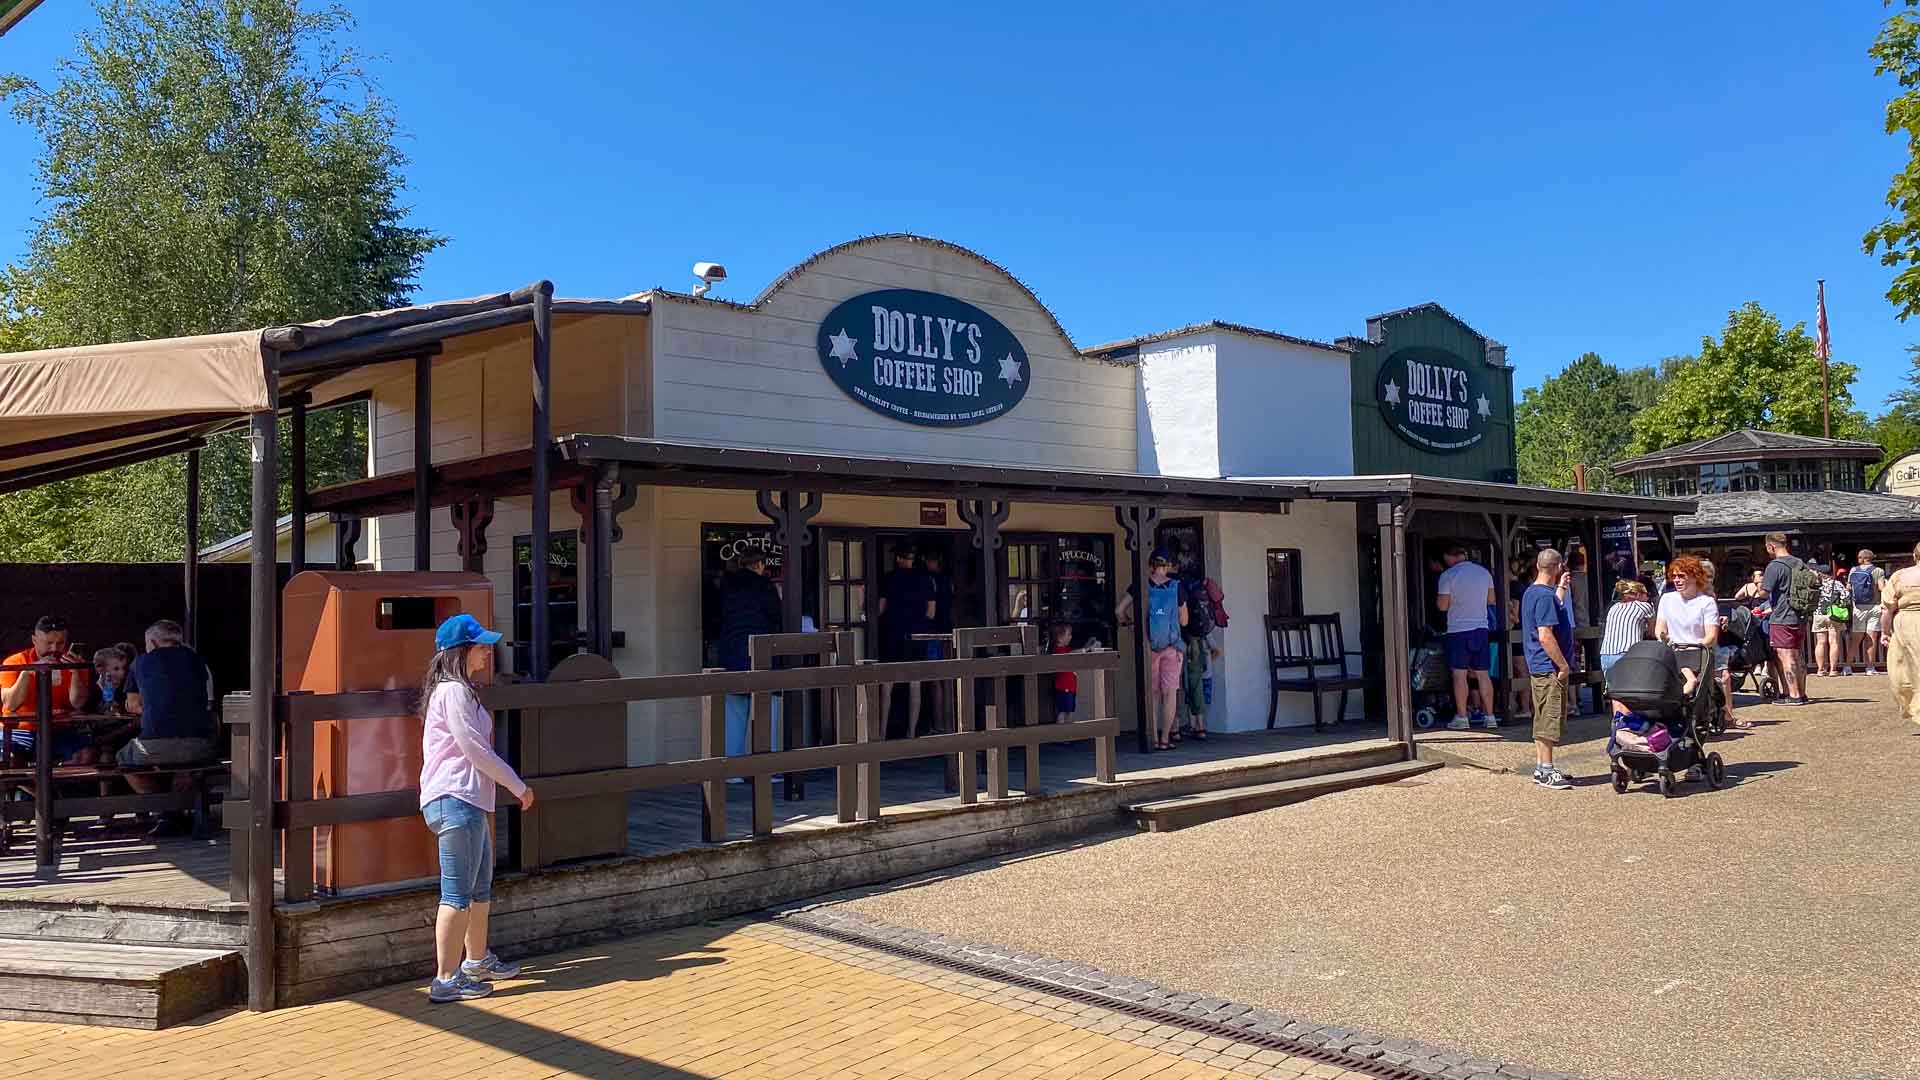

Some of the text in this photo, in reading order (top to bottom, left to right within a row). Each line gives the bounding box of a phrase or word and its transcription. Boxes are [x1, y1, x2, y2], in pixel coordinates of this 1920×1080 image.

[871, 305, 983, 365] DOLLY'S
[873, 356, 983, 397] COFFEE SHOP
[1406, 359, 1468, 403] DOLLY'S
[1408, 399, 1469, 430] COFFEE SHOP
